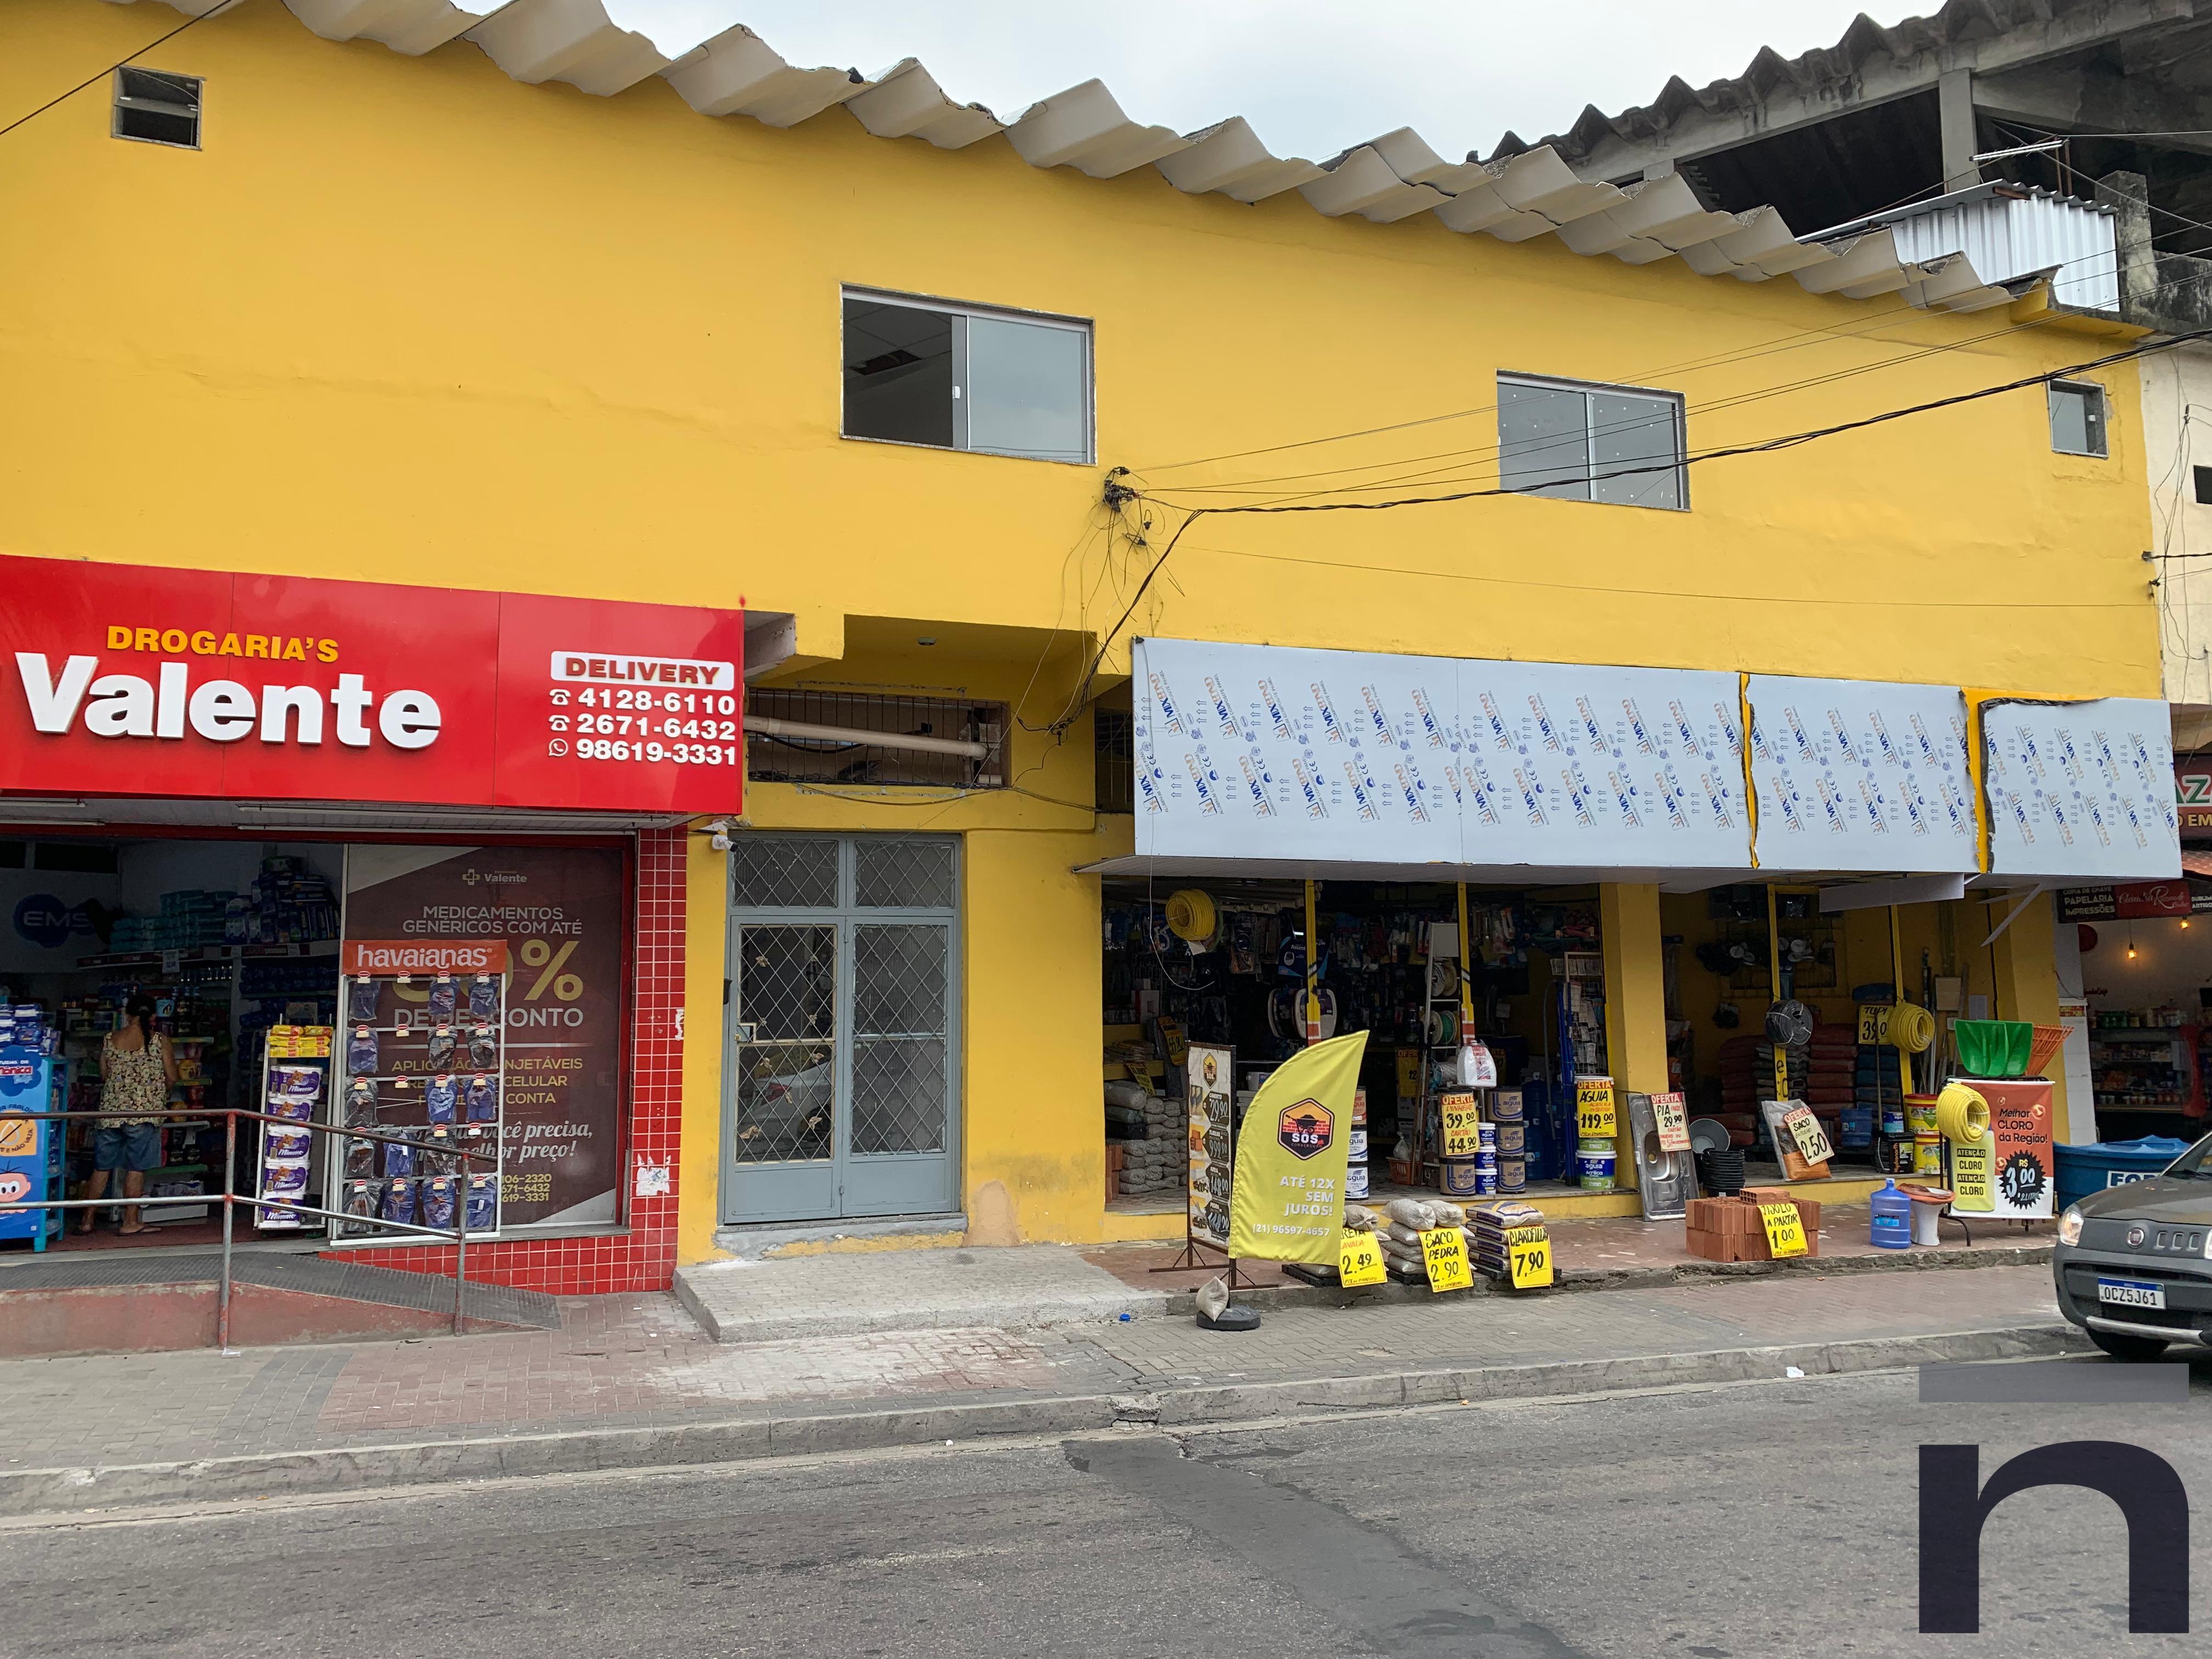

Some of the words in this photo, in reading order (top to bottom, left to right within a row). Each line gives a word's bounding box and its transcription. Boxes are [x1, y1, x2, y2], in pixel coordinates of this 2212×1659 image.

[107, 625, 339, 663] DROGARIA'S
[566, 657, 720, 684] DELIVERY
[15, 652, 442, 749] Valente
[578, 688, 735, 715] 4128-6110
[577, 714, 735, 740] 2671-6432
[576, 738, 735, 765] 98619-3331
[484, 873, 527, 882] Valente
[2064, 895, 2113, 905] PAPELARIA
[423, 906, 563, 919] MEDICAMENTOS
[2066, 904, 2115, 915] IMPRESSÕES
[22, 911, 89, 927] EMS
[402, 918, 503, 934] GENÉRICOS
[507, 921, 547, 934] COM
[550, 919, 582, 934] ATÉ
[394, 1009, 429, 1028] DE
[504, 1056, 583, 1069] NJETÁVEIS
[504, 1076, 567, 1087] CELULAR
[506, 1093, 556, 1104] CONTA
[1443, 1096, 1474, 1104] OFERTA
[1580, 1091, 1608, 1102] AGUIA
[1651, 1094, 1680, 1103] OFERTA
[1657, 1105, 1671, 1116] PIA
[1784, 1107, 1811, 1123] OFERTA
[2000, 1108, 2030, 1118] Melhor
[523, 1120, 592, 1142] precisa,
[1793, 1118, 1810, 1131] SACO
[1998, 1120, 2034, 1130] CLORO
[1291, 1133, 1319, 1144] SOS
[1999, 1133, 2011, 1142] da
[2014, 1133, 2048, 1145] Região!
[519, 1141, 577, 1163] preço!
[1960, 1160, 1982, 1170] CLORO
[2019, 1159, 2028, 1167] R$
[1279, 1175, 1306, 1188] ATÉ
[1311, 1178, 1335, 1190] 12X
[1305, 1191, 1334, 1203] SEM
[1960, 1186, 1984, 1195] CLORO
[1284, 1203, 1334, 1217] JUROS!
[1761, 1204, 1791, 1215] TIJOLO
[1774, 1214, 1798, 1226] PARTIR
[1252, 1223, 1271, 1234] (21)
[1273, 1225, 1330, 1236] 96597-4657
[1425, 1232, 1453, 1249] SACO
[1429, 1246, 1459, 1261] PEDRA
[2104, 1287, 2157, 1306] OCZ5J61
